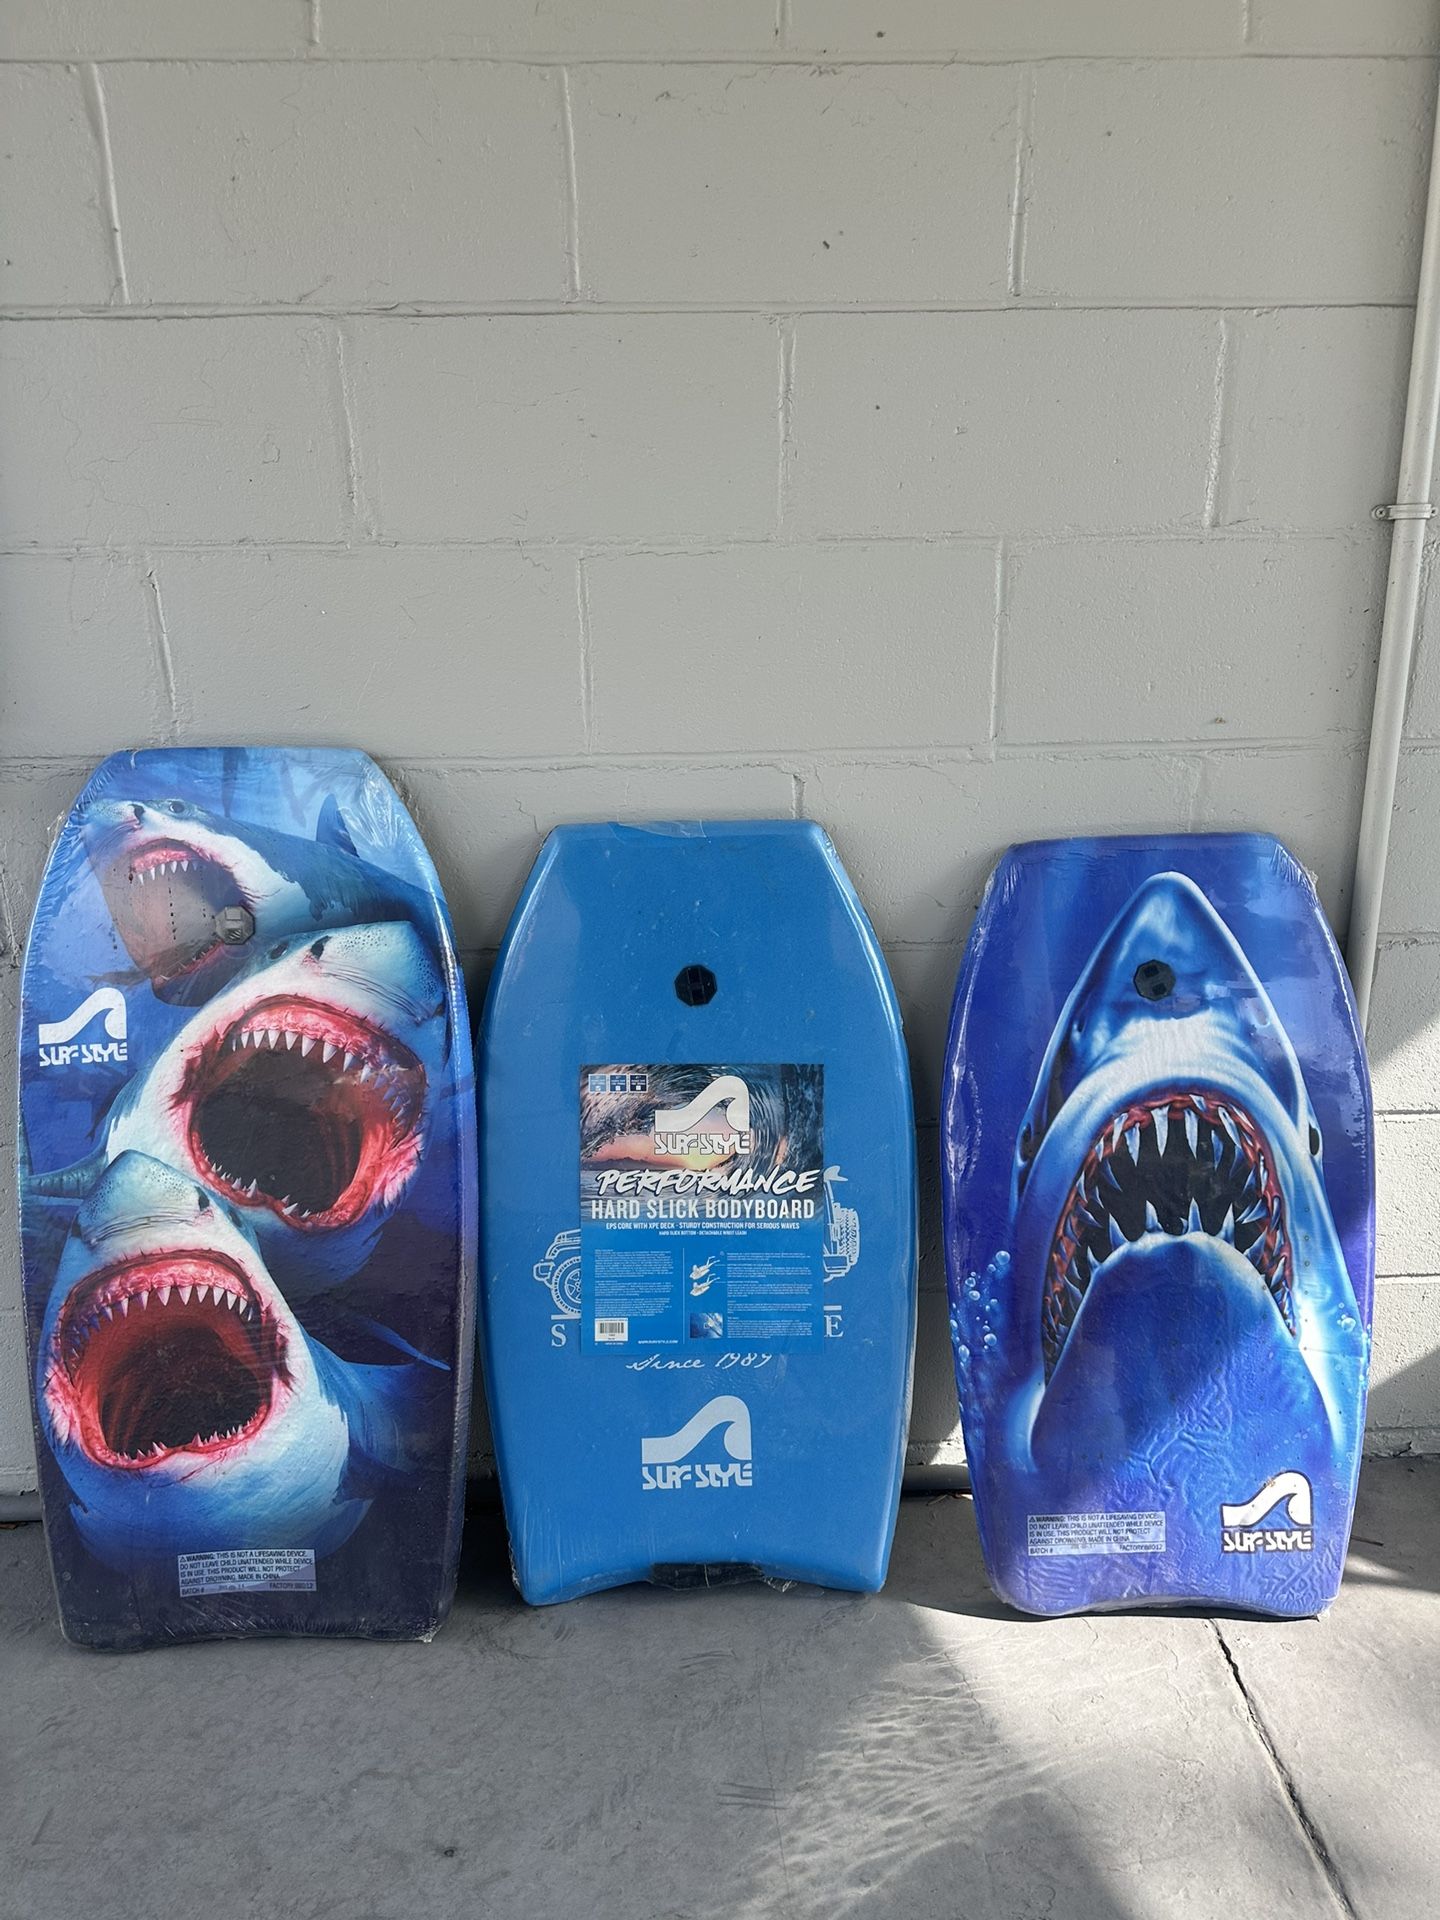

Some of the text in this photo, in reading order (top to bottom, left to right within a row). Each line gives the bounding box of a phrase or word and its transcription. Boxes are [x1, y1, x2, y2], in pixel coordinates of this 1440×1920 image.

[39, 1042, 128, 1067] SURF STYLE
[654, 1132, 750, 1155] SURF STYLE
[596, 1167, 821, 1196] PERFORMANCE
[591, 1198, 815, 1219] HARD SLICK BODYBOARD
[606, 1222, 617, 1230] EPS
[617, 1222, 632, 1230] CORE
[633, 1222, 648, 1230] WITH
[649, 1222, 659, 1230] XPE
[660, 1222, 675, 1230] DECK
[679, 1222, 701, 1230] STURDY
[701, 1222, 744, 1230] CONSTRUCTION
[745, 1222, 756, 1230] FOR
[756, 1222, 780, 1230] SERIOUS
[780, 1222, 800, 1230] WAVES
[642, 1463, 753, 1490] SURF STYLE
[1223, 1530, 1311, 1552] SURF STYLE
[186, 1553, 214, 1561] WARNING:
[181, 1587, 199, 1595] BATCH
